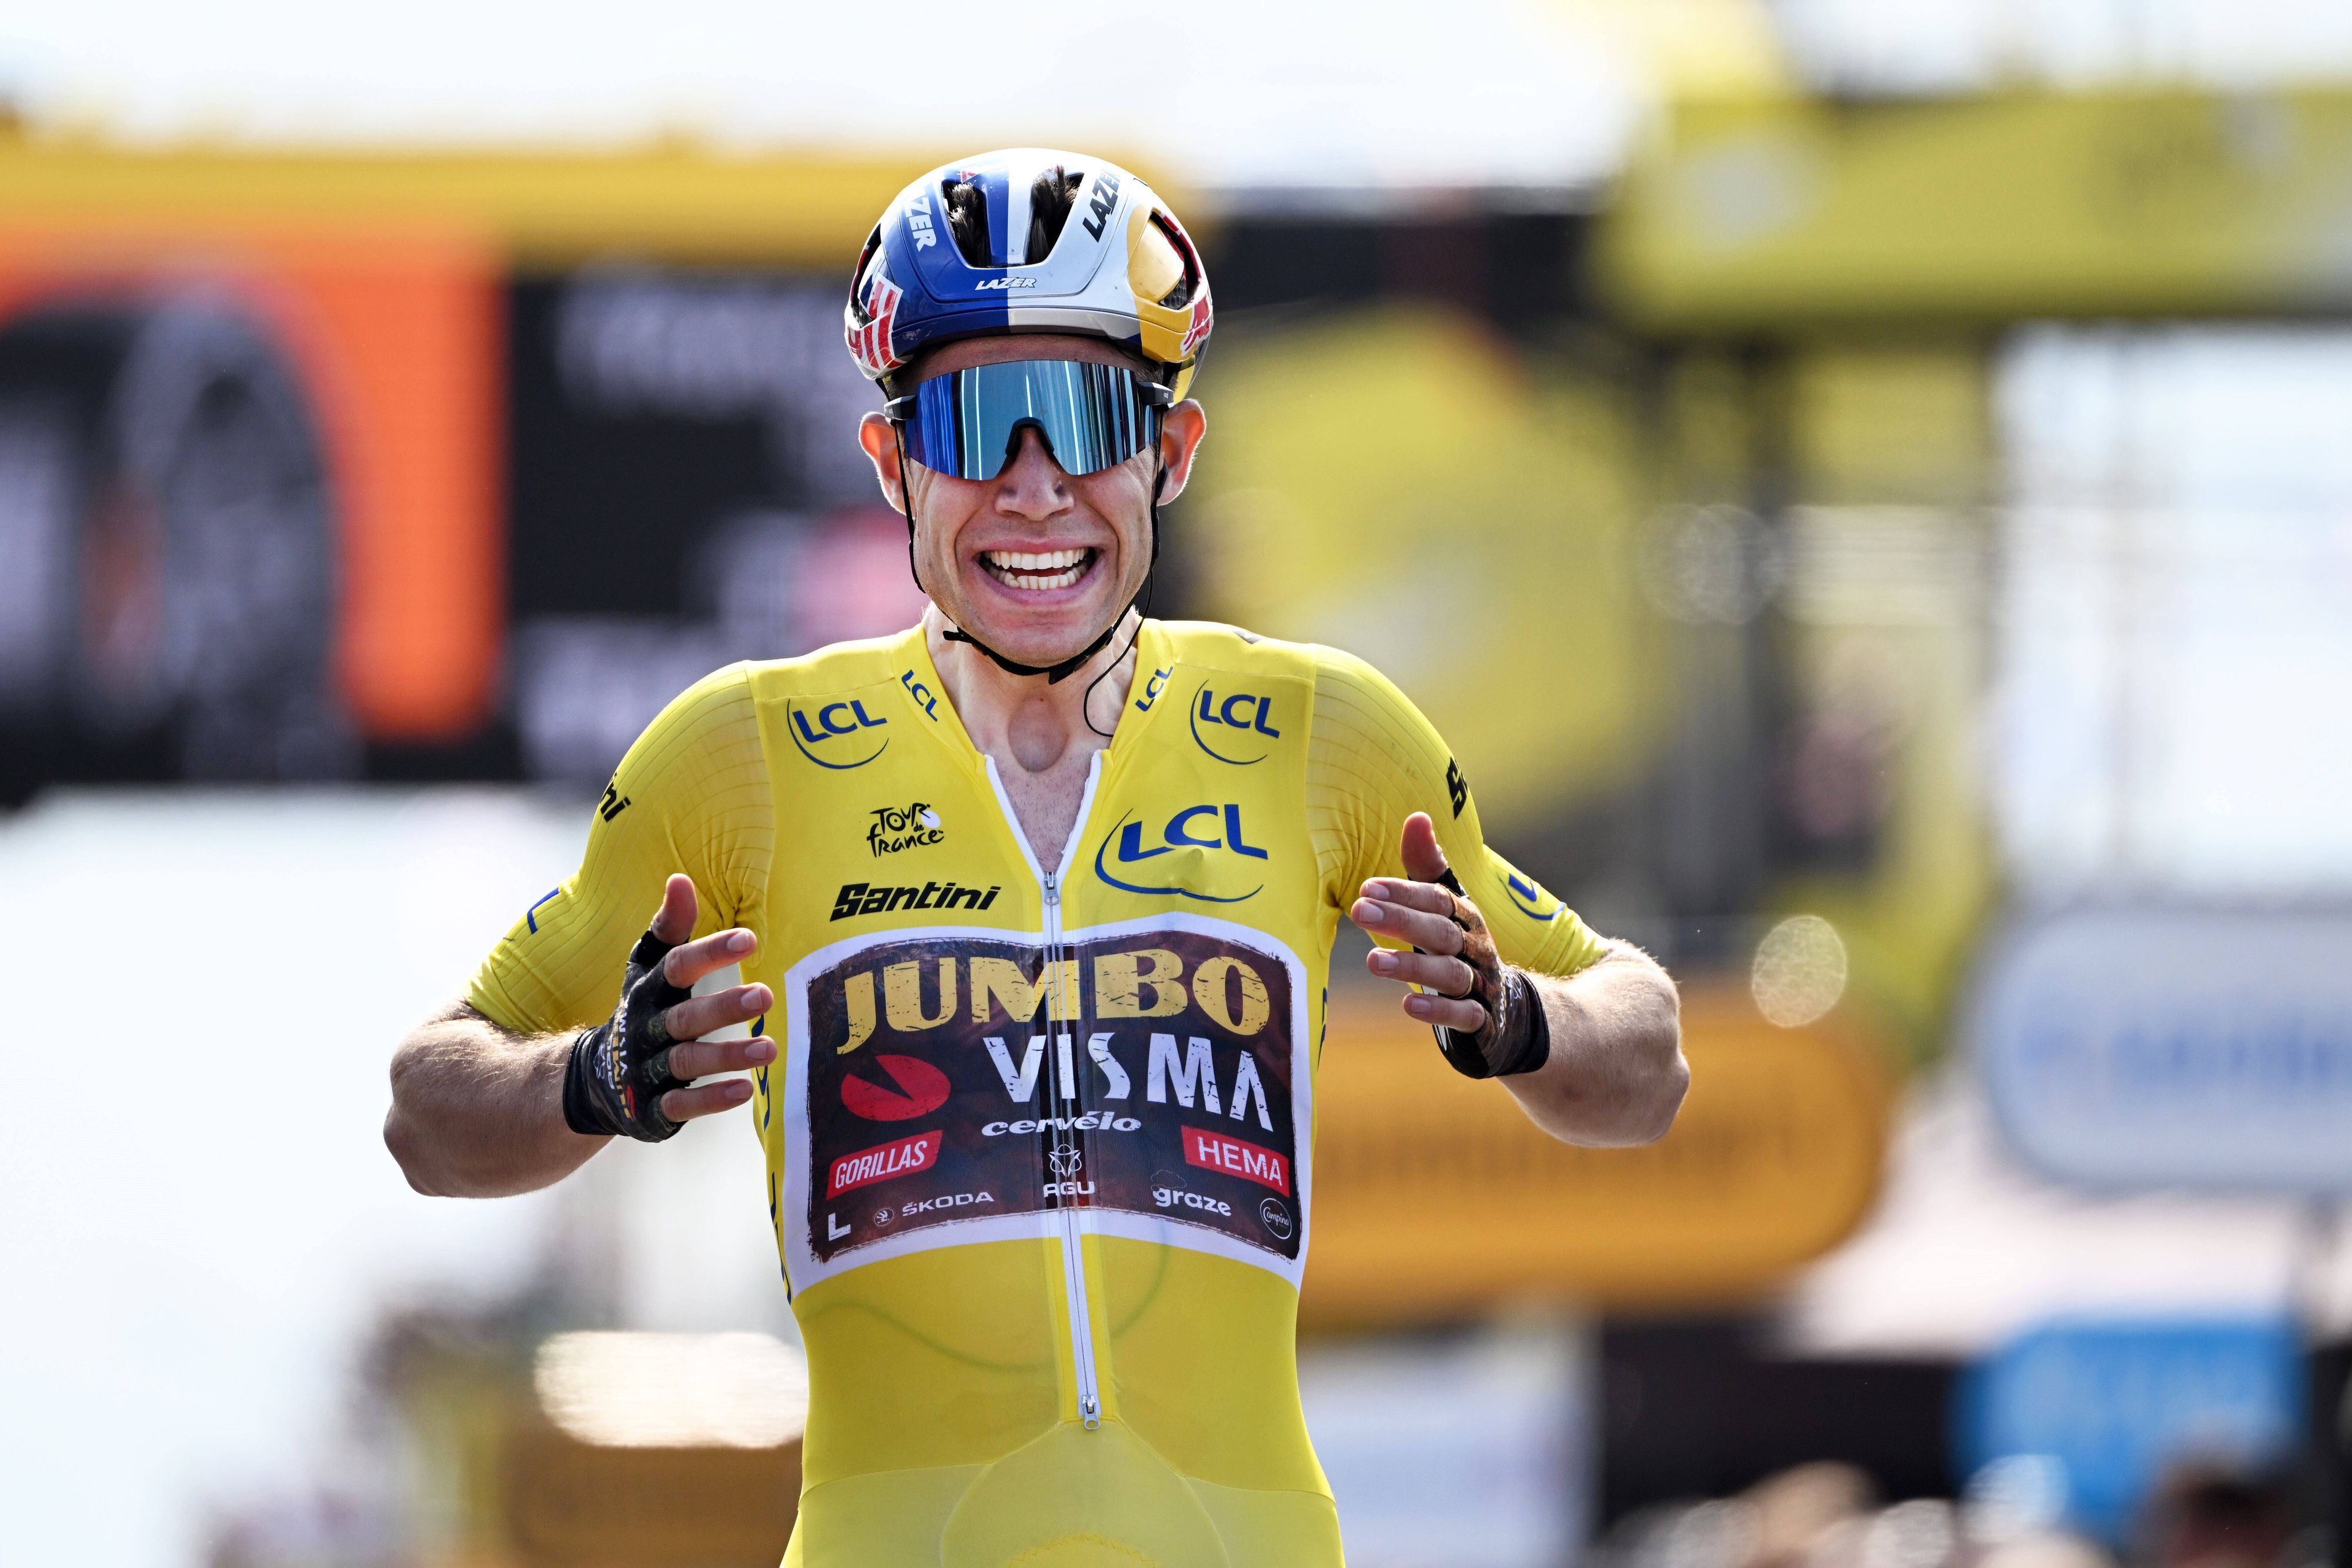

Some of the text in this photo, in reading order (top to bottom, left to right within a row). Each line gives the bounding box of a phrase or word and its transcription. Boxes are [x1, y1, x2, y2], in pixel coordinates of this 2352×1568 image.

[903, 197, 937, 252] ZER
[974, 278, 1036, 290] LAZER
[902, 670, 938, 721] LCL
[1135, 666, 1173, 711] LCL
[792, 700, 887, 743] LCL
[1200, 690, 1279, 738] LCL
[1118, 804, 1268, 862] LCL
[830, 881, 1001, 922] Santini
[837, 949, 1270, 1055] JUMBO
[983, 1032, 1274, 1132] VISMA
[981, 1111, 1141, 1136] cervélo
[835, 1141, 927, 1188] GORILLAS
[1197, 1136, 1283, 1186] HEMA
[902, 1192, 994, 1217] ŠKODA
[1043, 1181, 1095, 1198] AGU
[1152, 1186, 1232, 1216] graze
[1263, 1206, 1289, 1226] Campina
